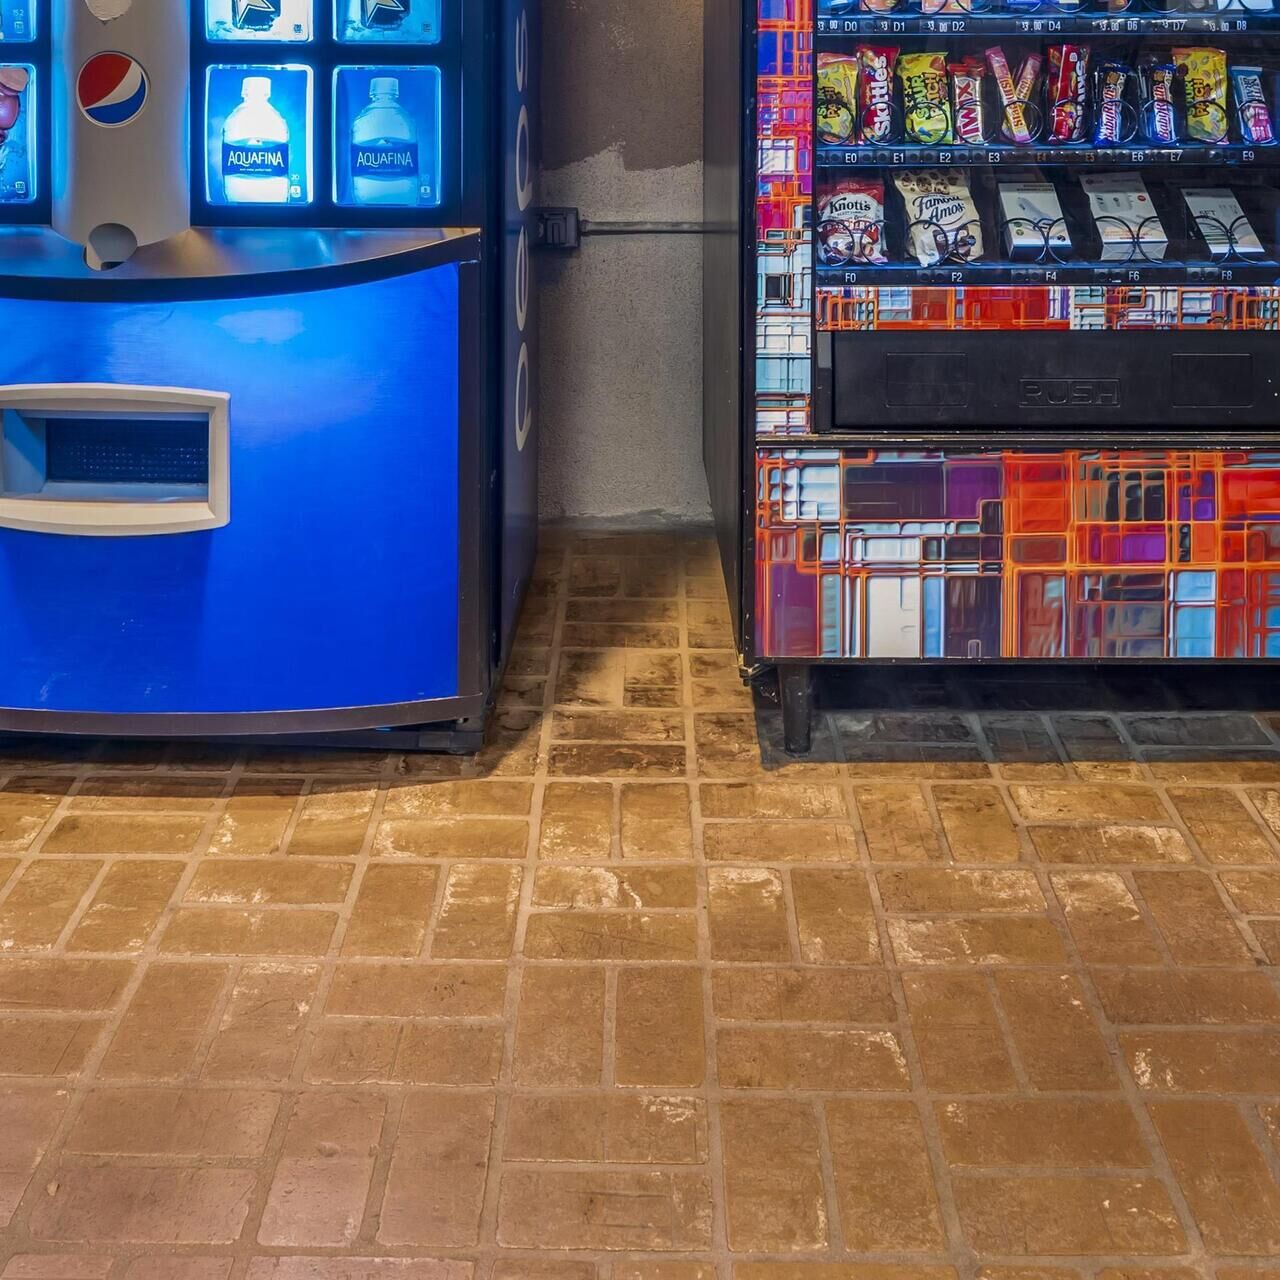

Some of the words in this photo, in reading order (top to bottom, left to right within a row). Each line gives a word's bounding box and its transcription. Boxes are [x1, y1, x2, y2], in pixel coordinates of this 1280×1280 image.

[893, 22, 905, 31] D1
[952, 22, 965, 31] D2
[1048, 22, 1061, 31] D4
[1127, 21, 1138, 31] D6
[1173, 21, 1185, 31] D7
[1236, 21, 1247, 30] D8
[871, 55, 892, 136] Skittles
[959, 82, 980, 140] TWIX
[228, 151, 284, 167] AQUAFINA
[356, 151, 413, 168] AQUAFINA
[893, 153, 904, 162] E1
[940, 153, 951, 162] E2
[988, 152, 1000, 162] E3
[1132, 152, 1143, 162] E6
[1170, 152, 1181, 162] E7
[1242, 151, 1255, 161] E9
[830, 196, 871, 214] Knott's
[951, 273, 962, 282] F2
[1046, 271, 1057, 281] F4
[1129, 271, 1140, 280] F6
[1222, 271, 1233, 280] F8
